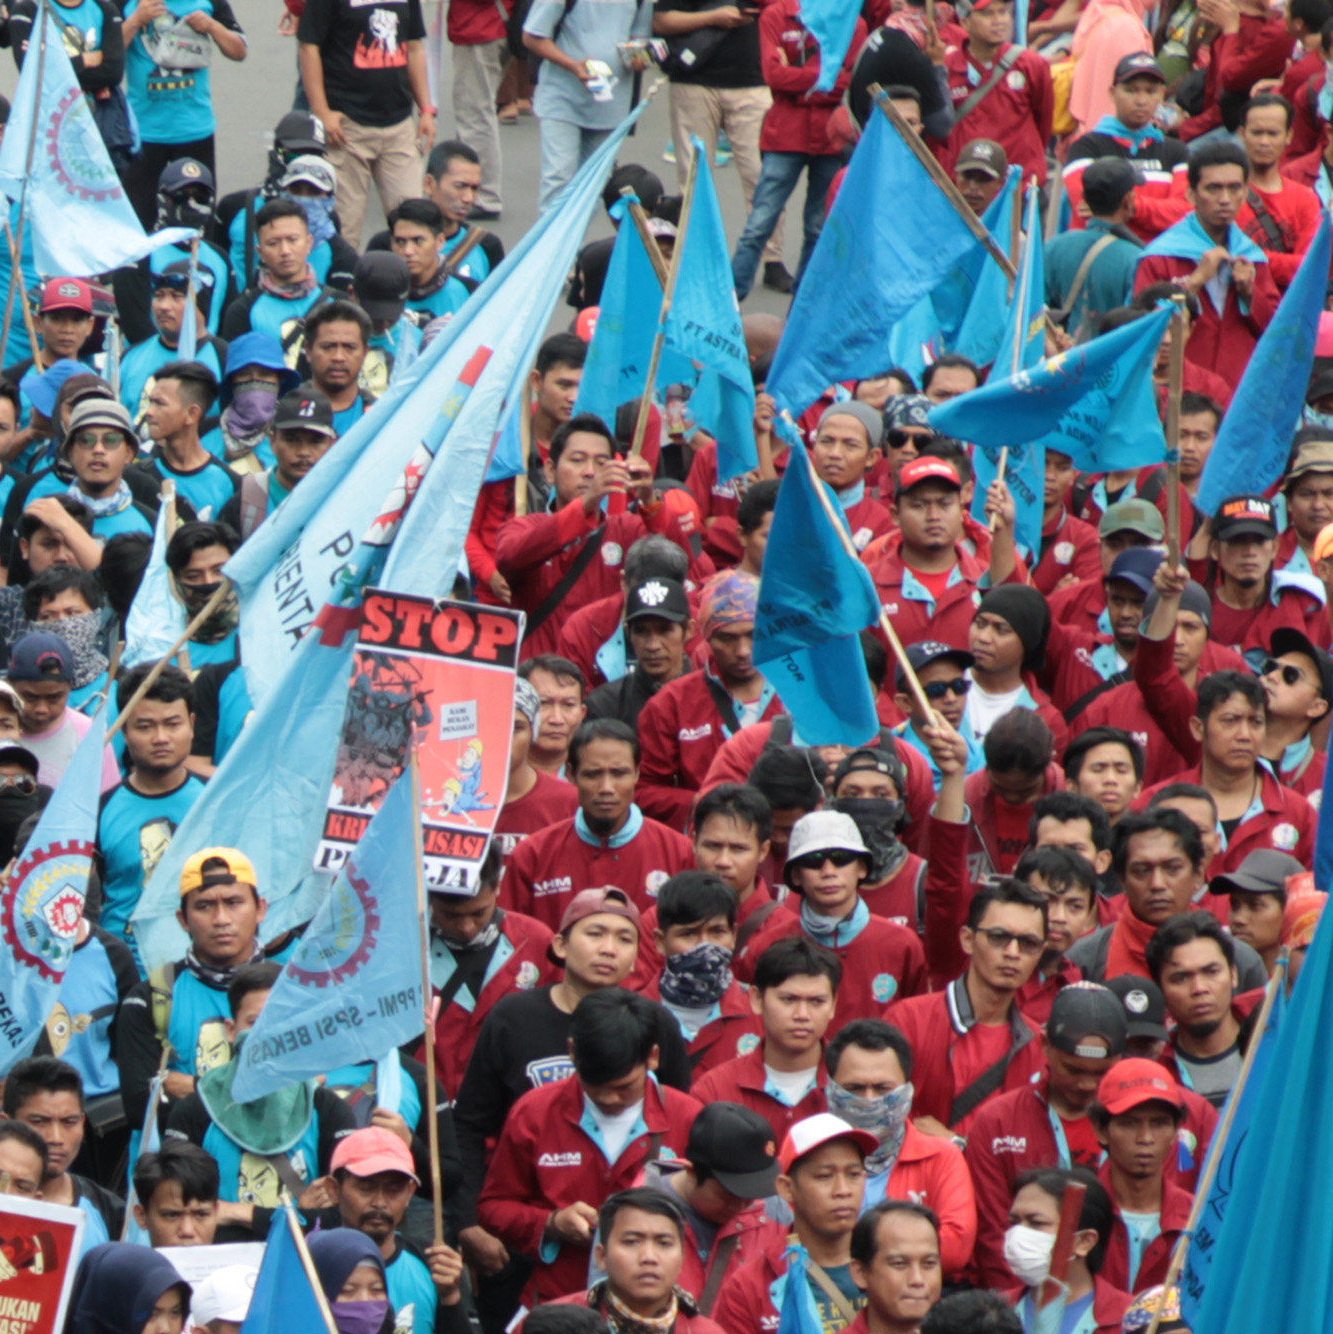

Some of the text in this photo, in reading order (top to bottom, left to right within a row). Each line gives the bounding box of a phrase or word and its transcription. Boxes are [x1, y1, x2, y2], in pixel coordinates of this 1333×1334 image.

[703, 330, 742, 358] ASTRA
[1224, 498, 1271, 516] MAY DAY
[359, 594, 517, 661] STOP
[538, 1152, 582, 1164] AHM
